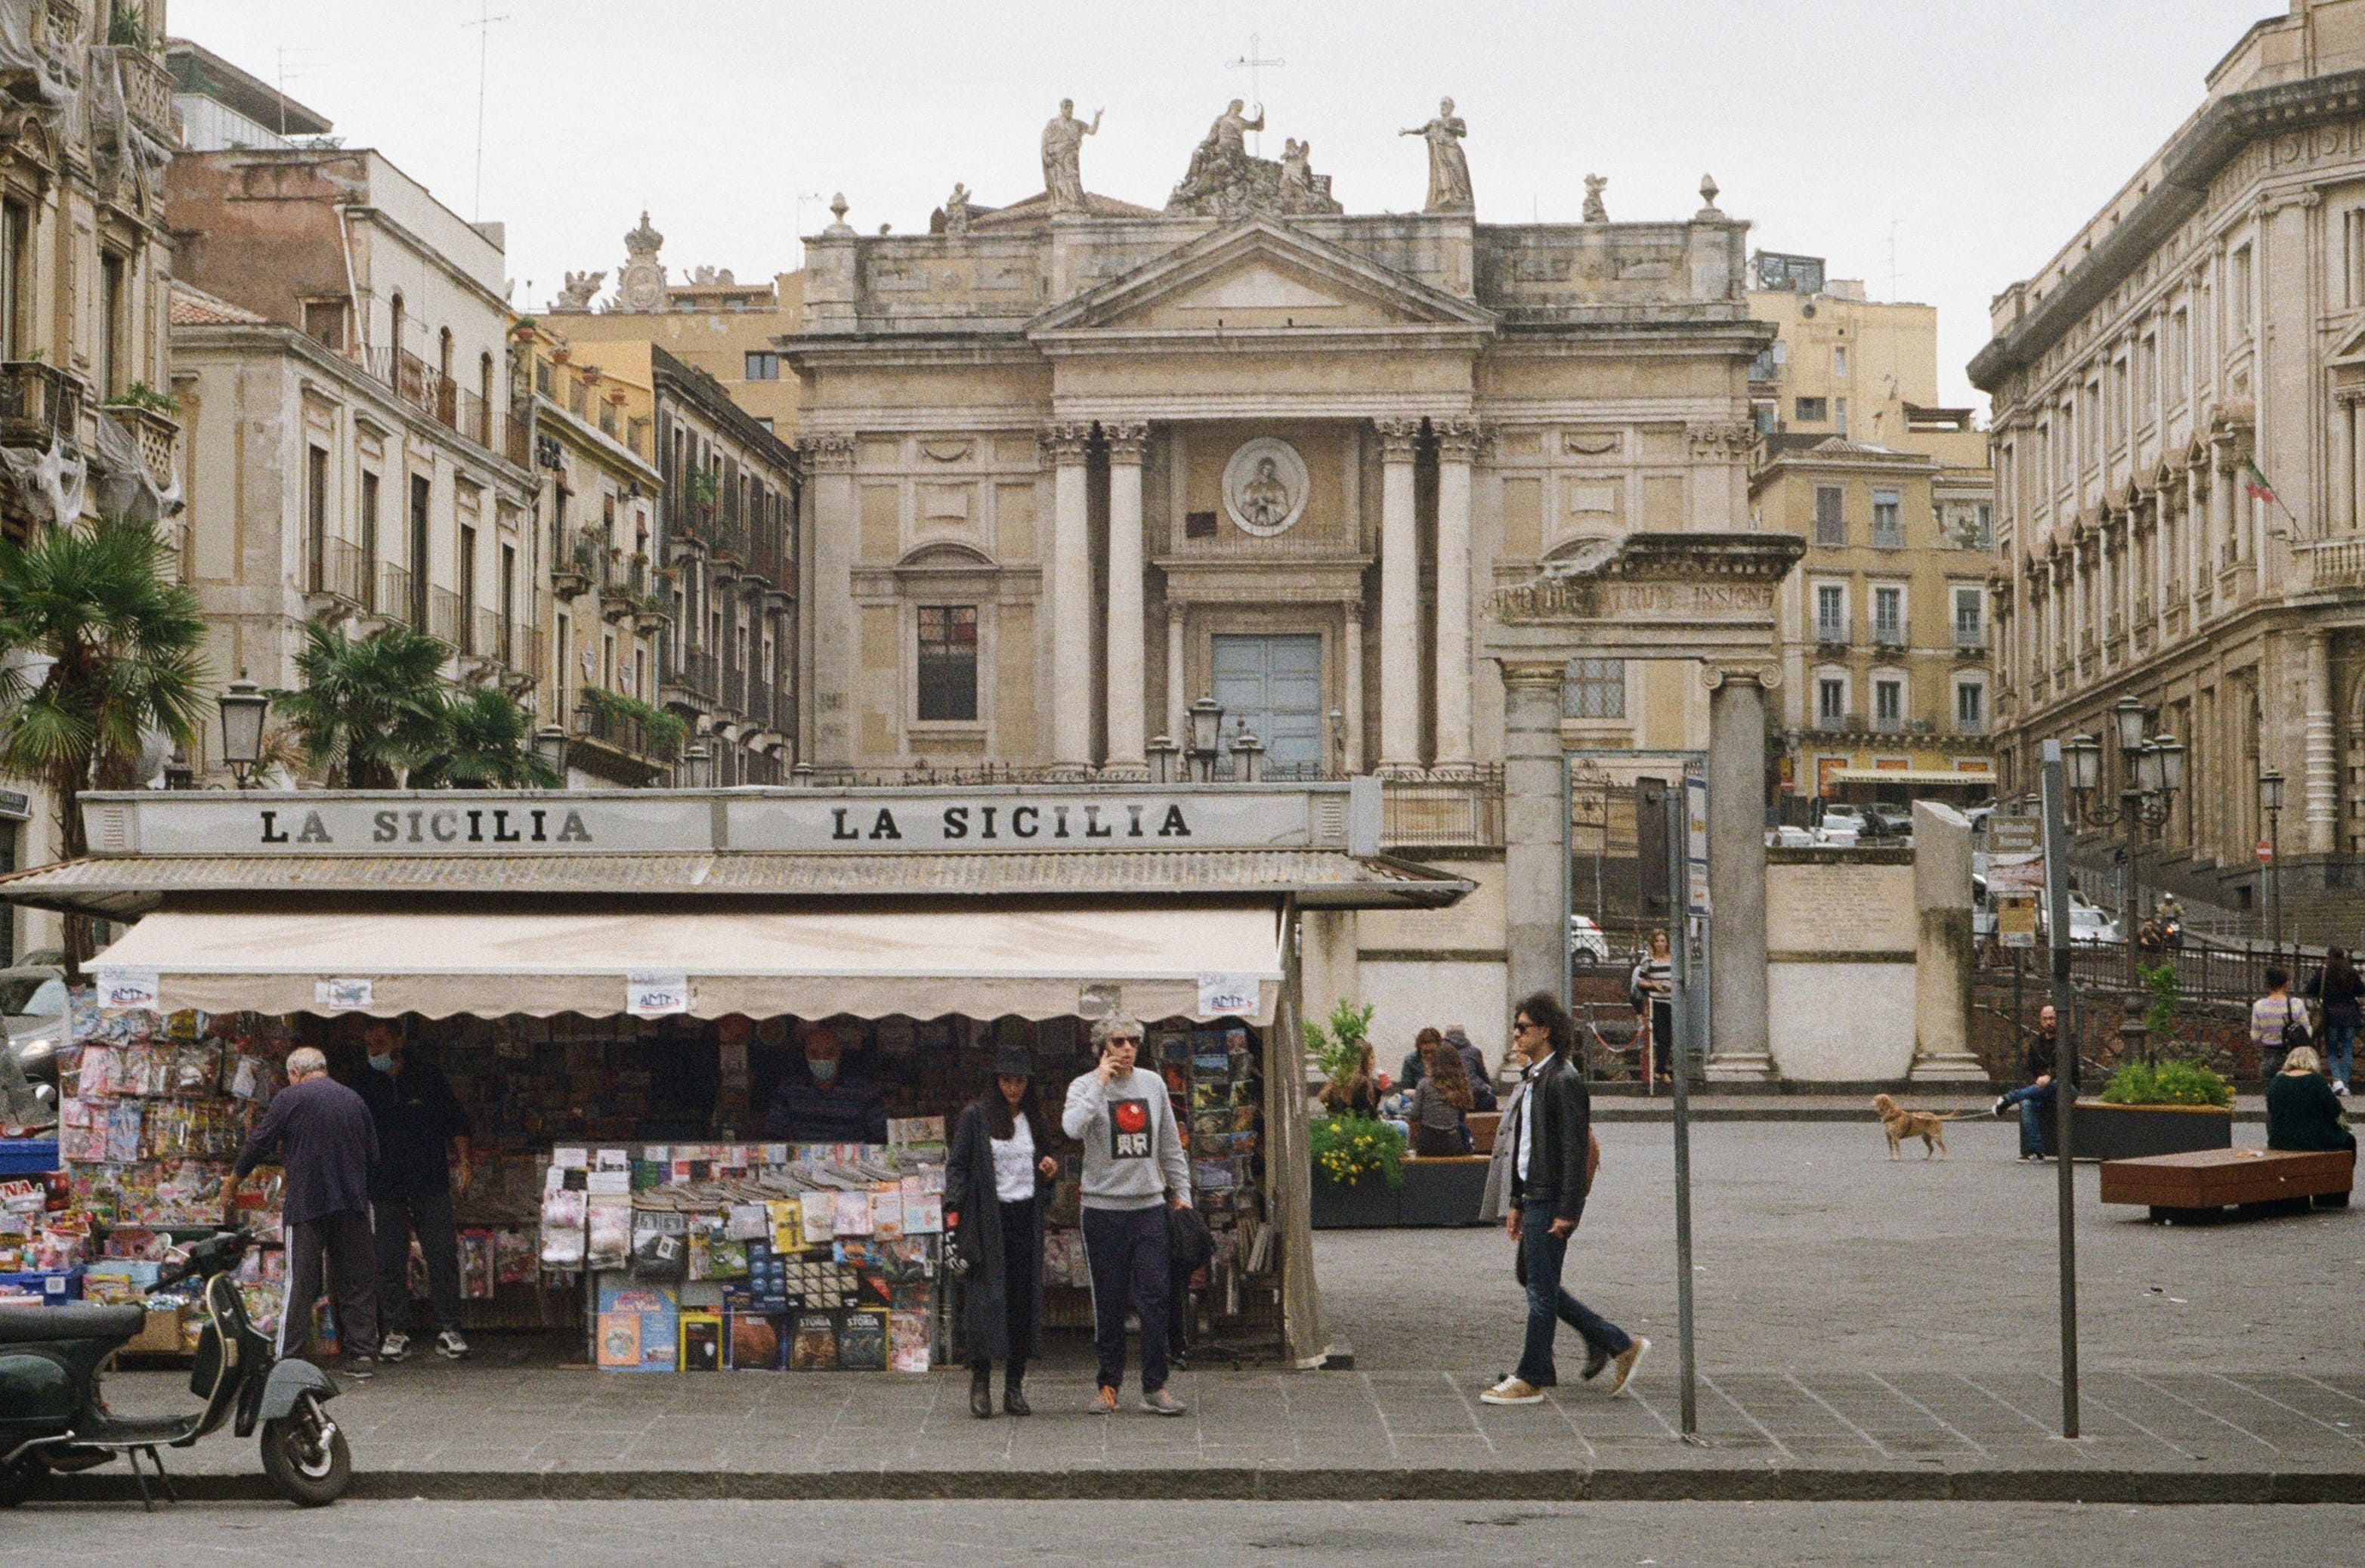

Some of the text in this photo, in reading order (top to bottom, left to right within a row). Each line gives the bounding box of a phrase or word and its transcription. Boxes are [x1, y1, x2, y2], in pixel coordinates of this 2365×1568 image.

[261, 809, 593, 843] LA SICILIA
[832, 804, 1192, 840] LA SICILIA
[639, 993, 672, 1007] AMT
